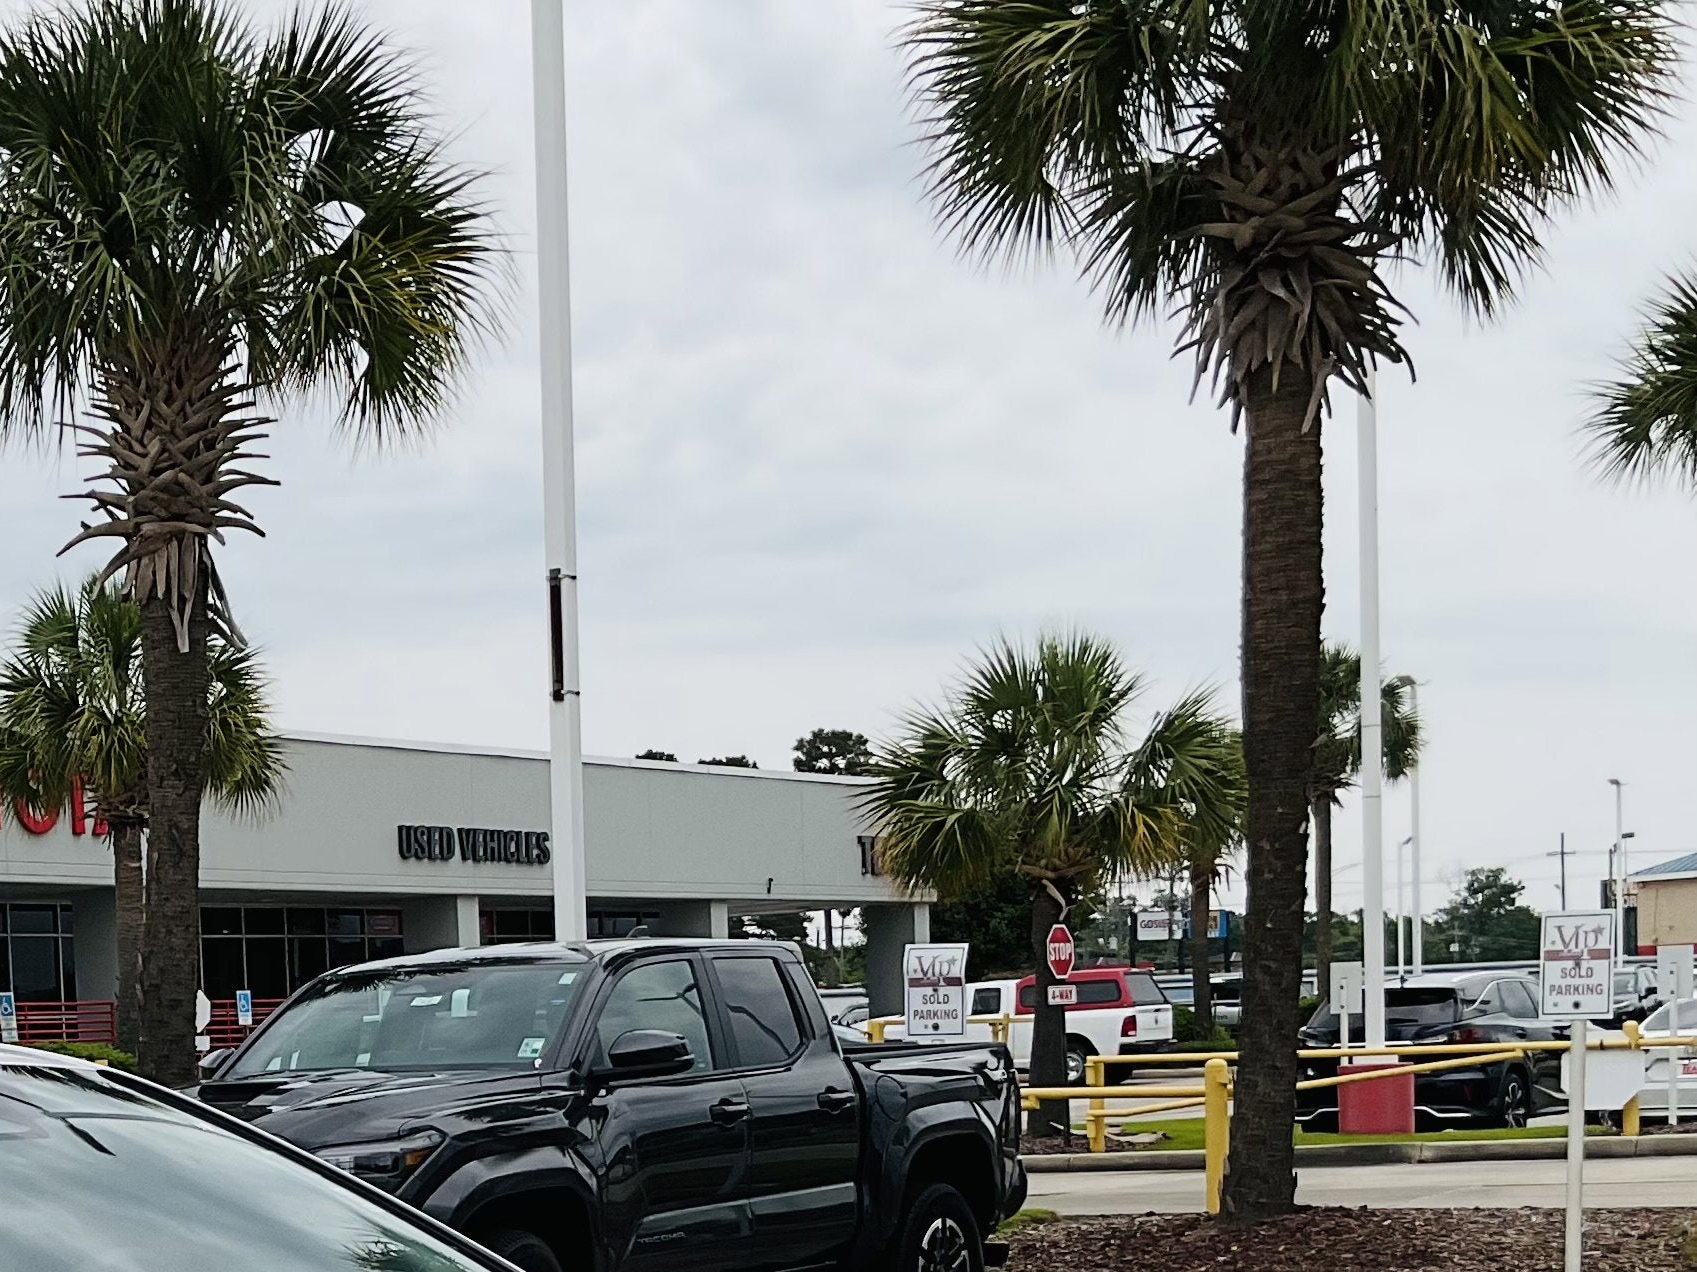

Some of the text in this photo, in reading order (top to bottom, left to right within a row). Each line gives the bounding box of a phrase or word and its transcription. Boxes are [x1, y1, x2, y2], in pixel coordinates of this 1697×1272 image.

[397, 824, 551, 865] USED VEHICLES
[1049, 942, 1072, 961] STOP
[1560, 966, 1594, 979] SOLD
[1052, 989, 1073, 1001] 4-WAY
[1549, 983, 1603, 997] PARKING
[922, 993, 950, 1005] SOLD
[913, 1008, 959, 1020] PARKING
